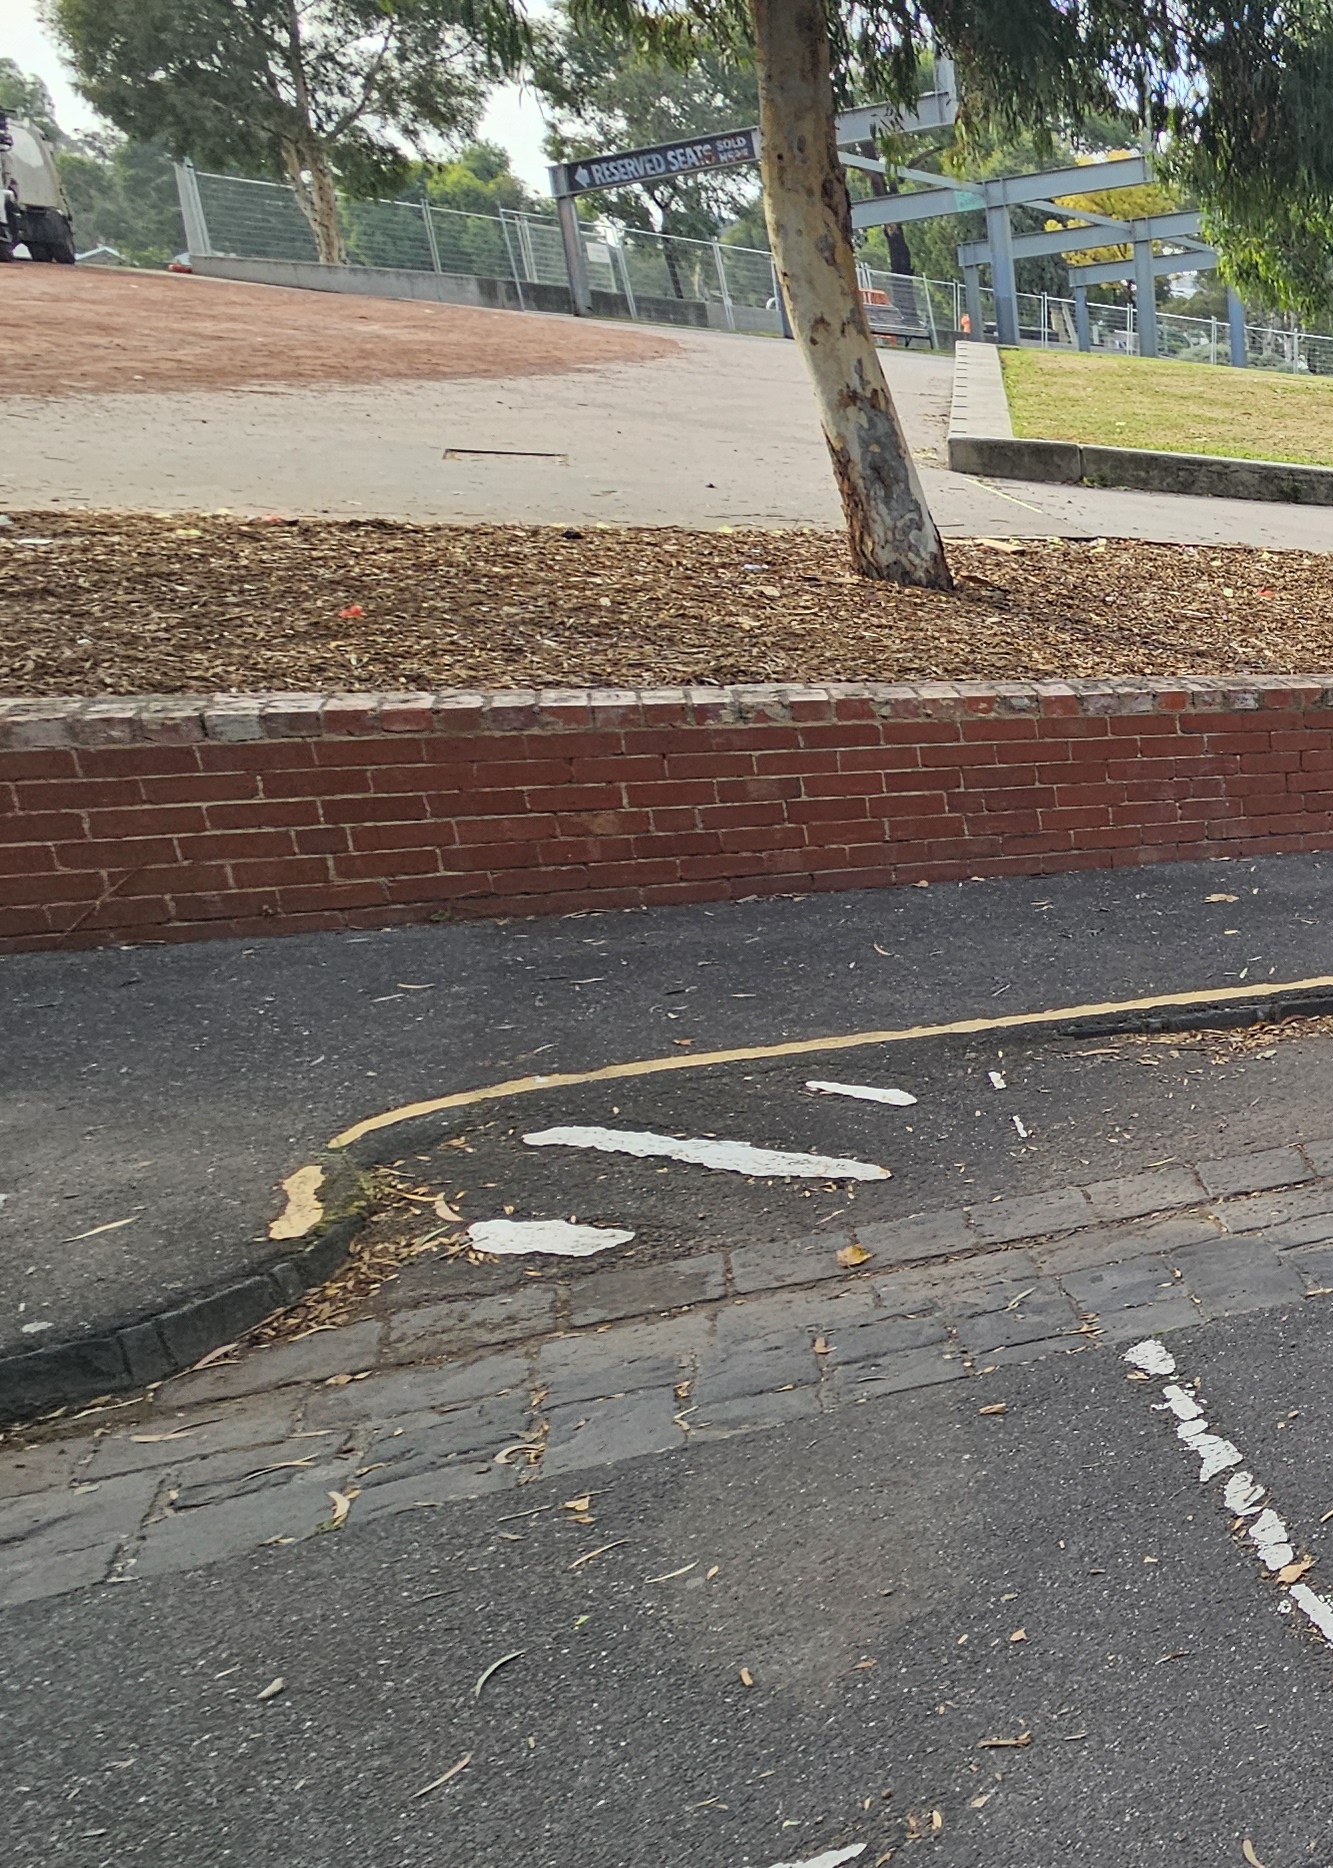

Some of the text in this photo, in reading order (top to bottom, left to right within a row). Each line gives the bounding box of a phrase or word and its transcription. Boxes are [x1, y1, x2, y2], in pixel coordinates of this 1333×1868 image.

[715, 136, 747, 151] SOLD
[591, 144, 715, 185] RESERVED SEATS
